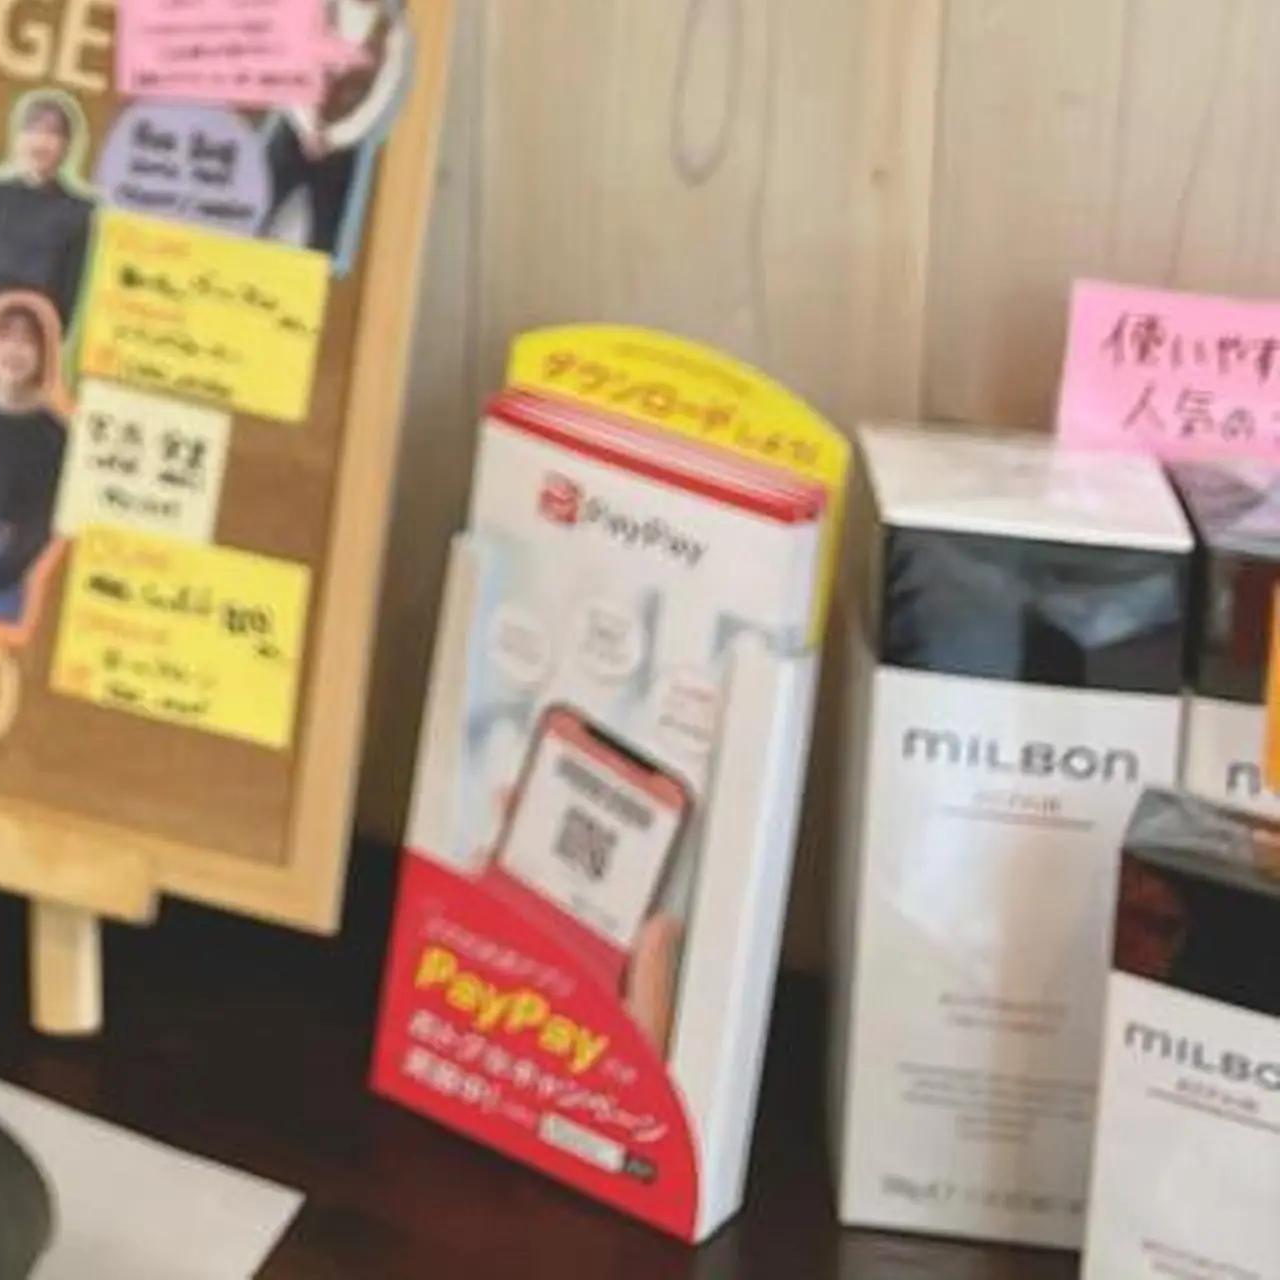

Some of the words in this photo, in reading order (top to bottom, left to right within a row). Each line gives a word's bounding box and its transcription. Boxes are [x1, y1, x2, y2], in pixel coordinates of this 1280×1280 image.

[1121, 380, 1280, 443] 人気の
[586, 494, 709, 568] PayPay
[414, 945, 609, 1076] PayPay
